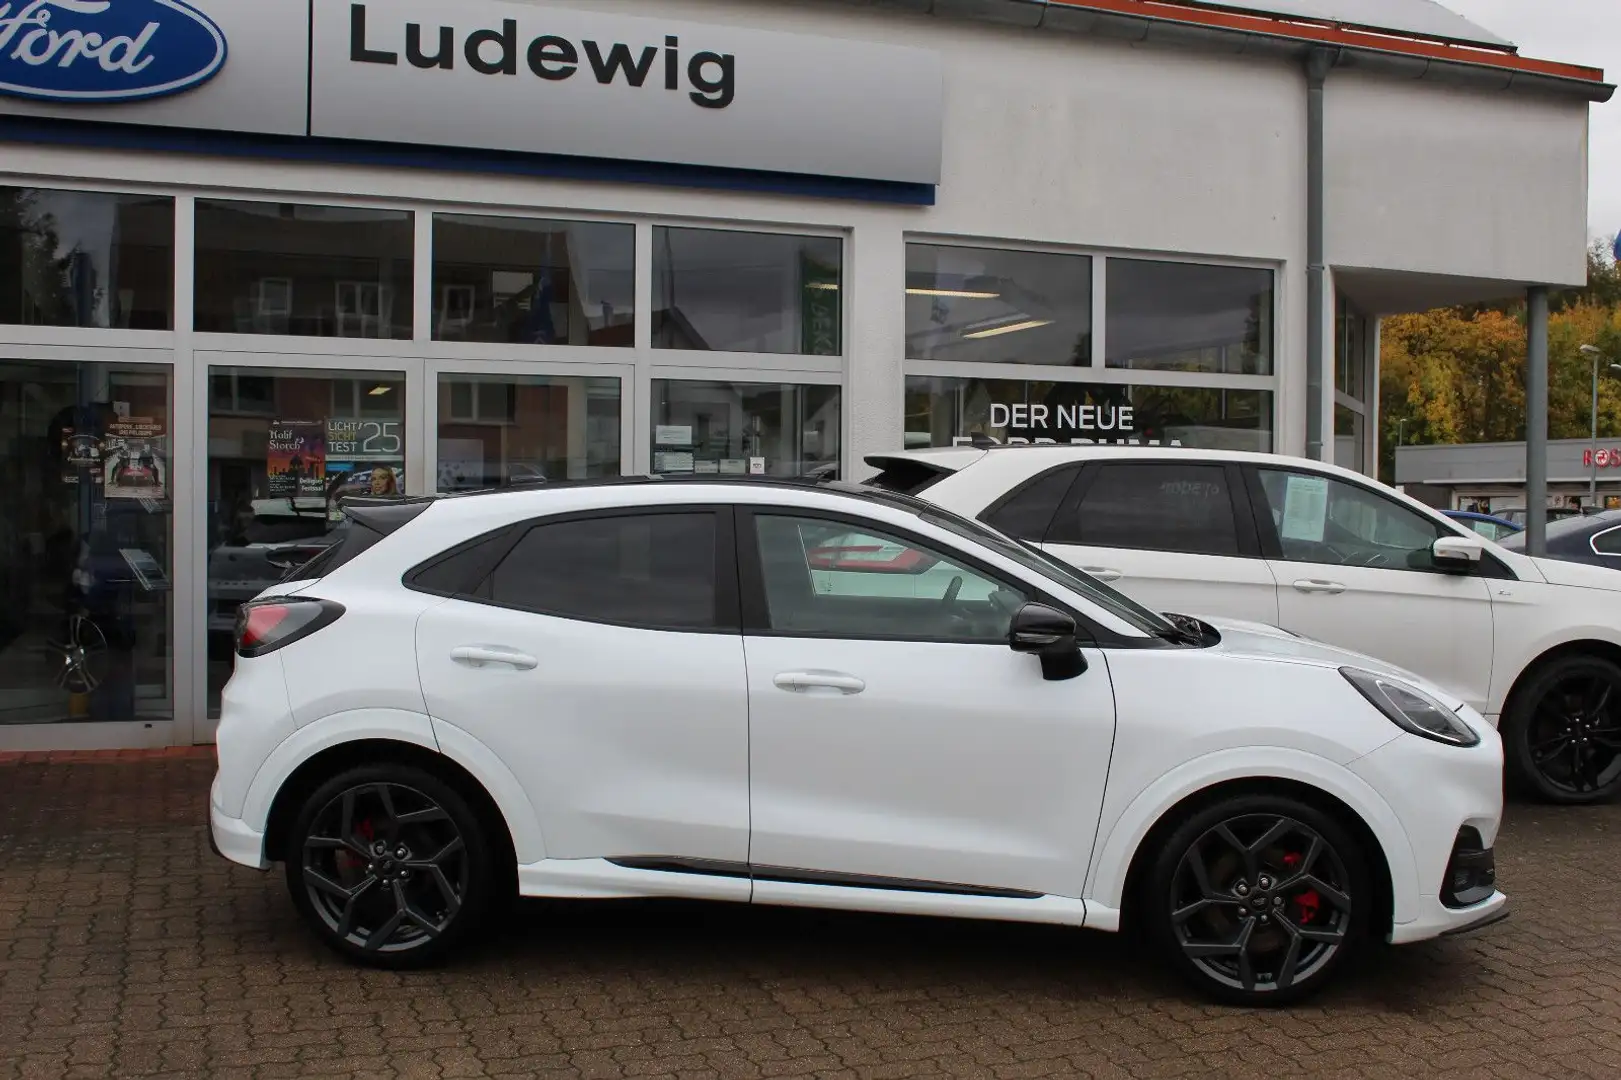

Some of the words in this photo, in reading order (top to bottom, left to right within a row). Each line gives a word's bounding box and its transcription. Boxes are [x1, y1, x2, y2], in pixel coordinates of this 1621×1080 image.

[350, 3, 735, 109] Ludewig
[990, 403, 1048, 429] DER
[1057, 405, 1134, 430] NEUE
[328, 422, 357, 431] LICHT
[328, 441, 358, 452] TEST
